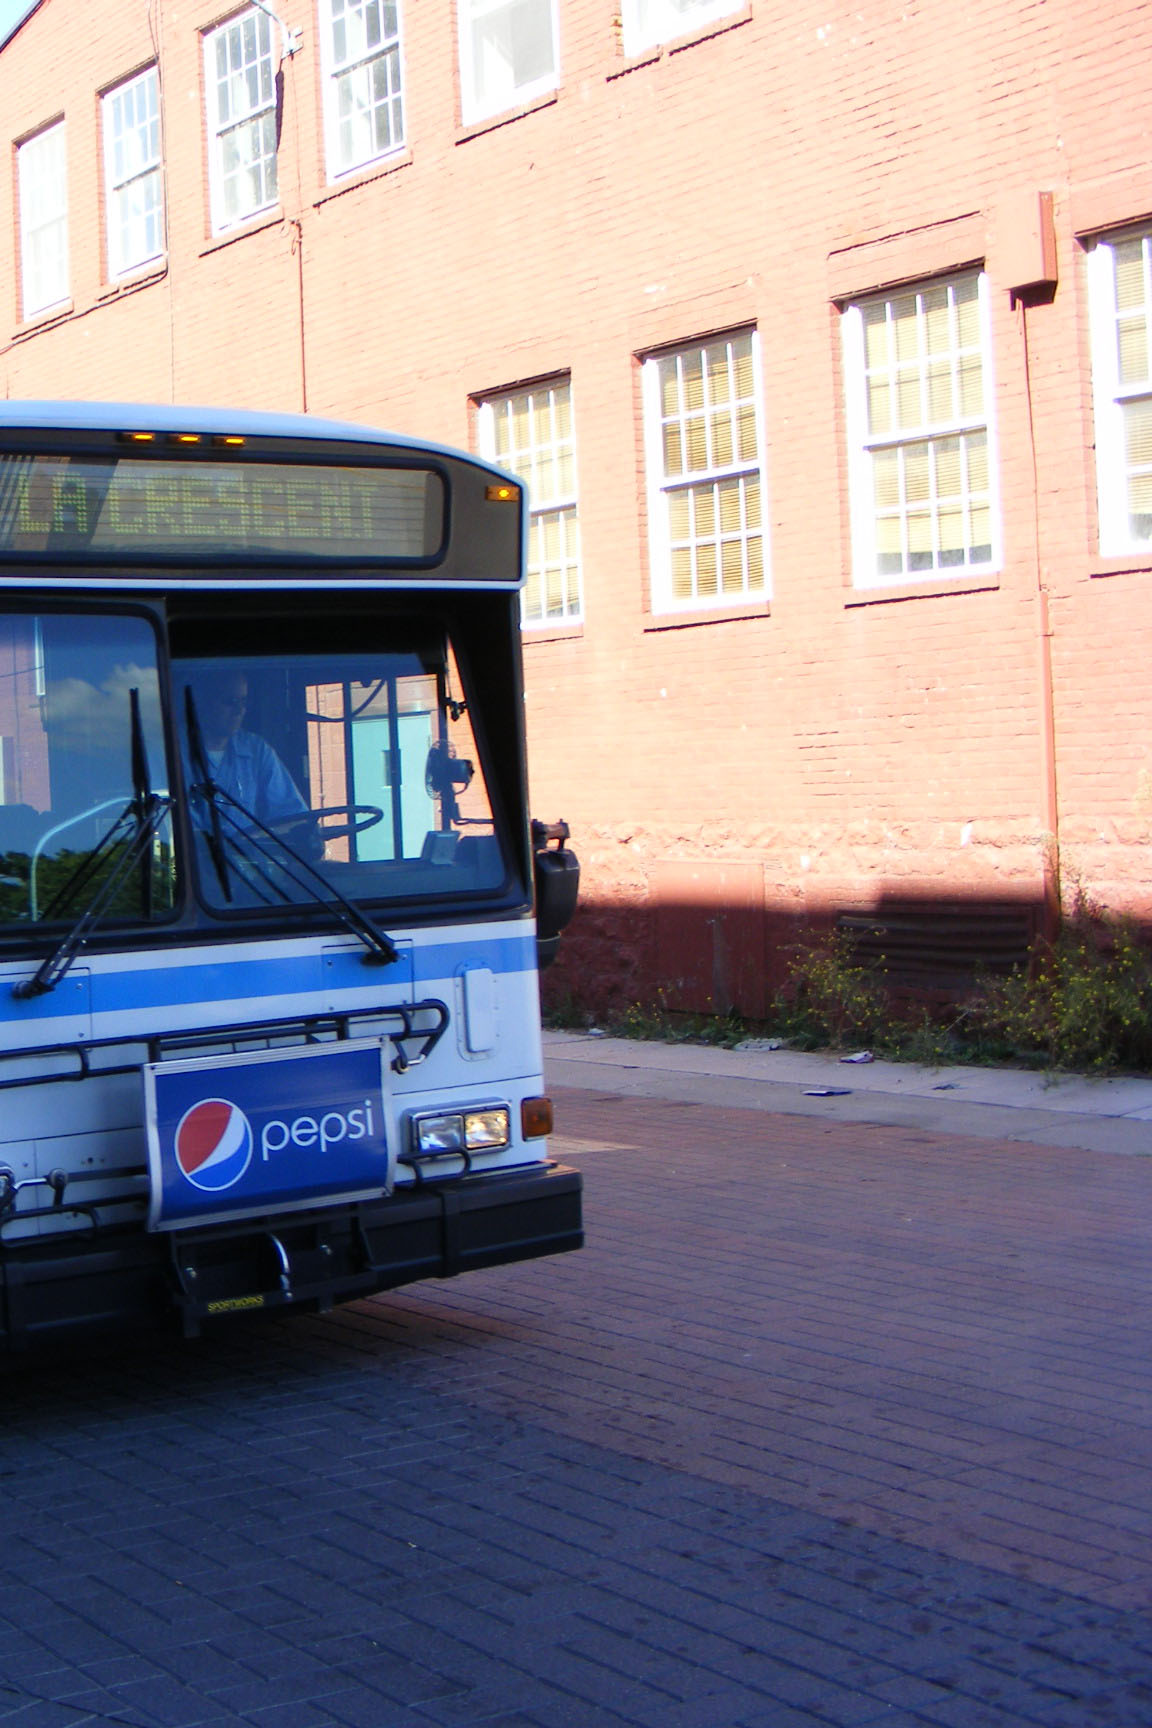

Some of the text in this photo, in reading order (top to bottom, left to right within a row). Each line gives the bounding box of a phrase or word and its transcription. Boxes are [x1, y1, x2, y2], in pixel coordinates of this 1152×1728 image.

[17, 470, 89, 533] LA
[108, 472, 376, 539] CRESCENT
[261, 1099, 375, 1161] pepsi
[207, 1294, 265, 1312] SPORTWORKS
